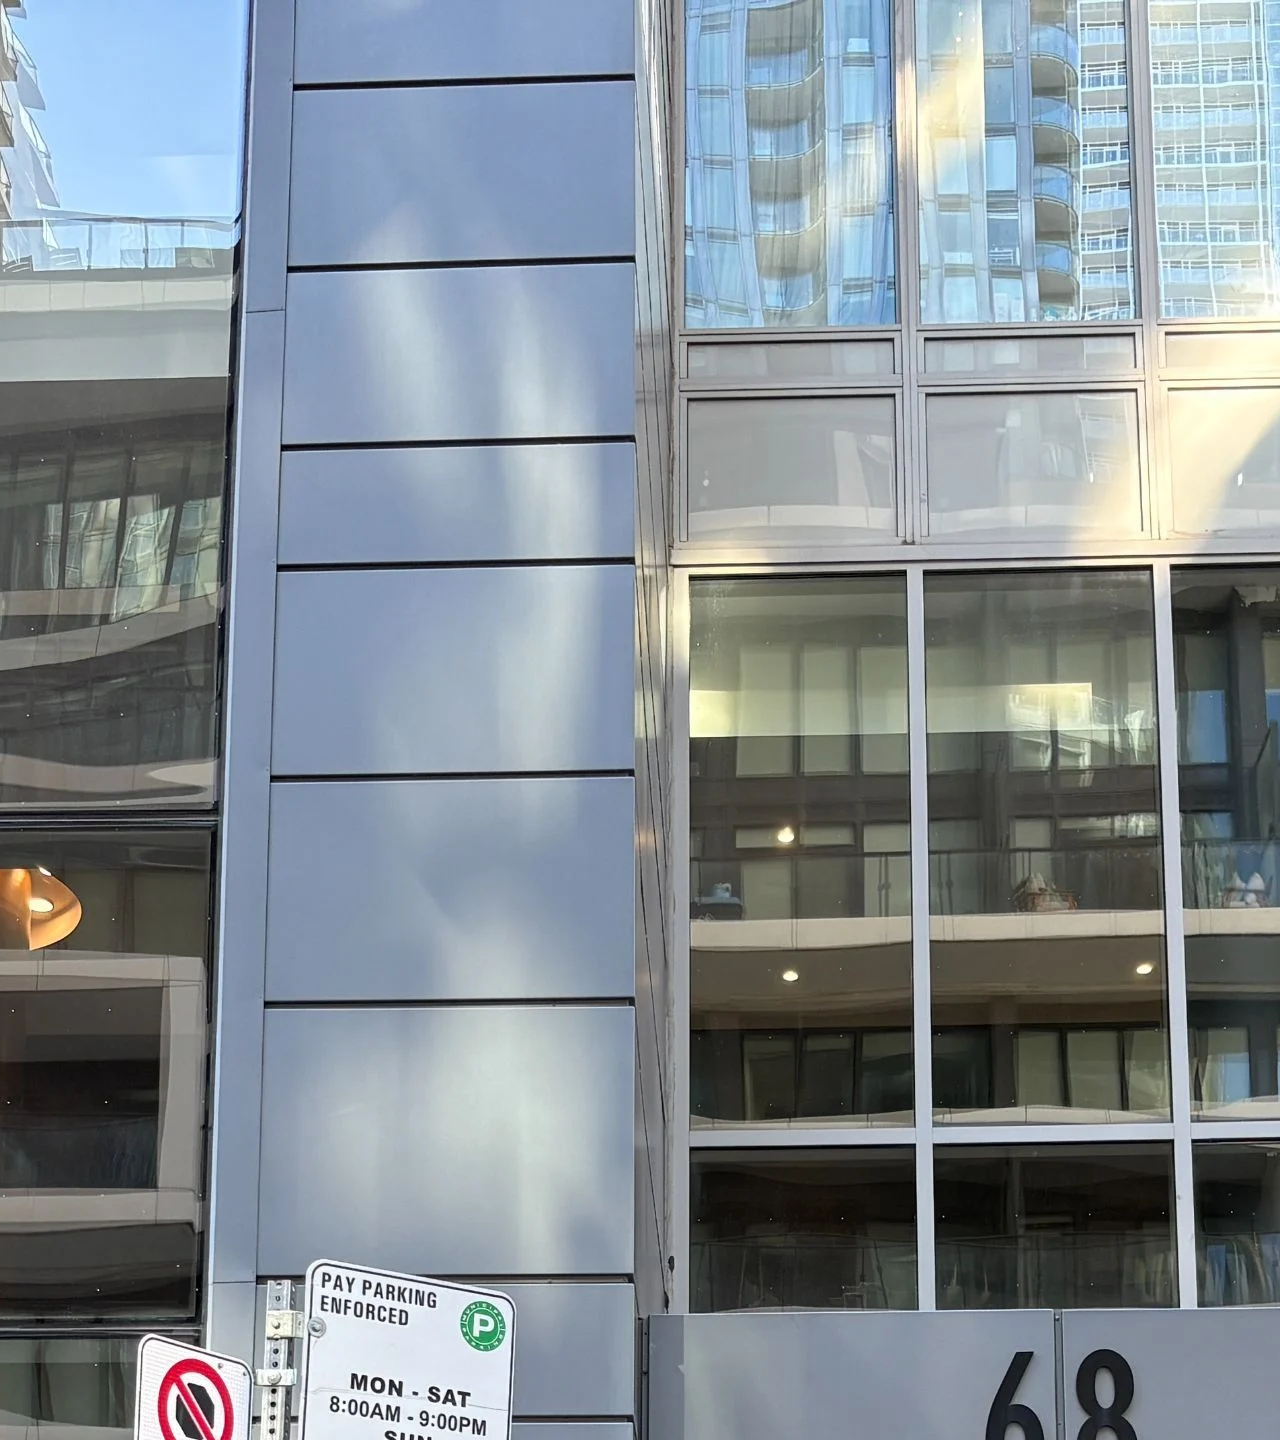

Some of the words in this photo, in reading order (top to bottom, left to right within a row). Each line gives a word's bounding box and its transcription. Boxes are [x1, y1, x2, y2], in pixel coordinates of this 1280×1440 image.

[320, 1272, 356, 1294] PAY
[362, 1279, 438, 1309] PARKING
[320, 1295, 409, 1327] ENFORCED
[472, 1312, 495, 1338] P
[350, 1372, 403, 1398] MON
[427, 1386, 471, 1409] SAT
[329, 1395, 401, 1424] 8:00AM
[420, 1410, 487, 1437] 9:00PM
